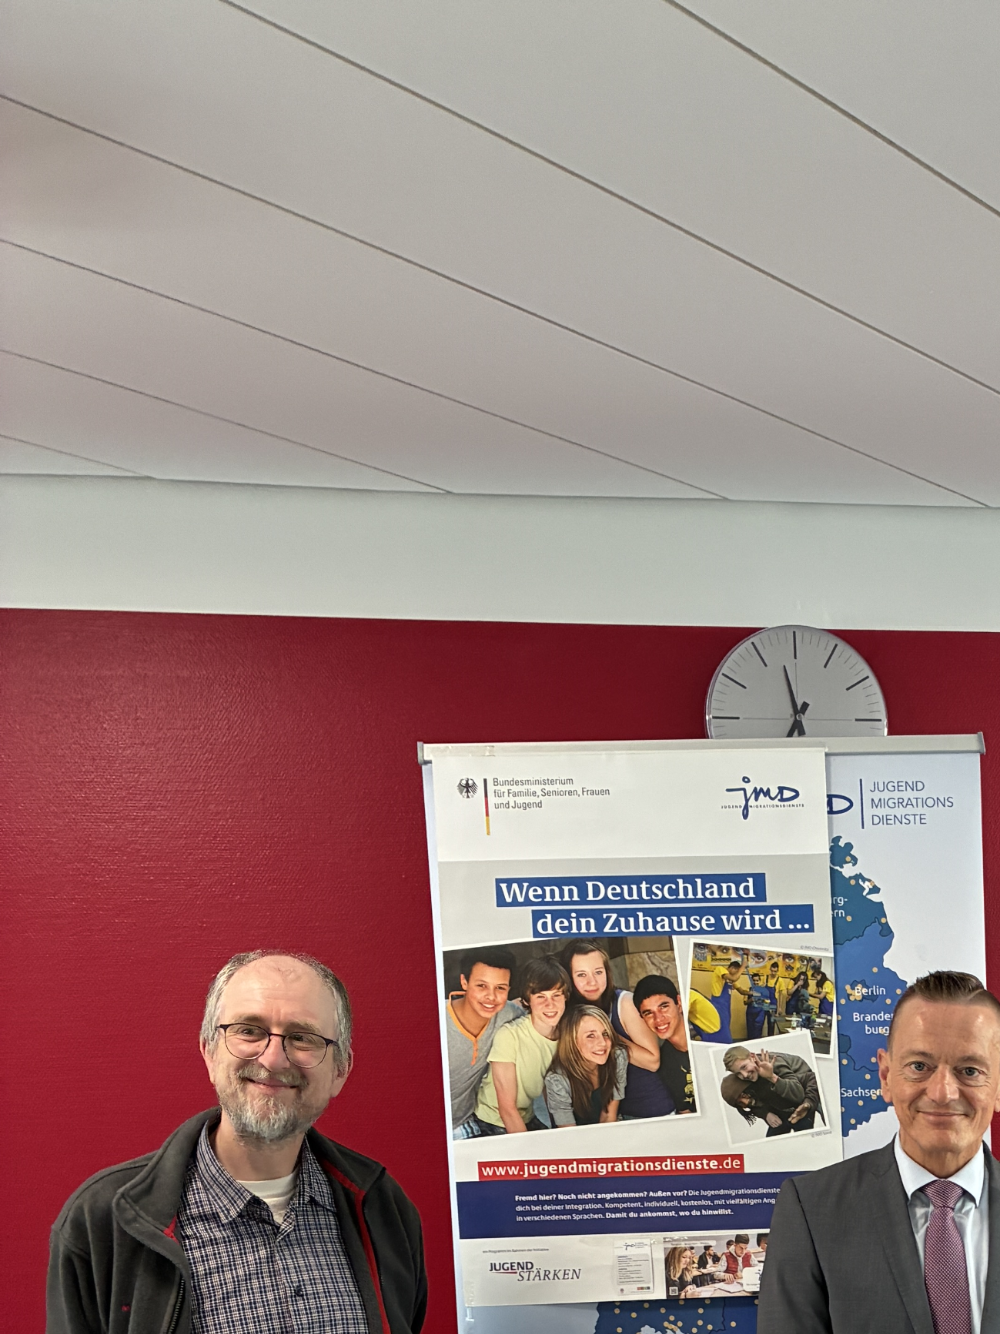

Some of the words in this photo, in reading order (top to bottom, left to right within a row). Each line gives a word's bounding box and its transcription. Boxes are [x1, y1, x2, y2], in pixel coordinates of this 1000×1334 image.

[493, 777, 574, 786] Bundesministerium
[870, 781, 925, 793] JUGEND
[494, 789, 506, 798] für
[507, 788, 540, 798] Familie,
[541, 788, 580, 797] Senioren,
[582, 787, 610, 796] Frauen
[494, 801, 510, 809] und
[511, 800, 542, 810] Jugend
[871, 796, 954, 809] MIGRATIONS
[871, 814, 927, 826] DIENSTE
[500, 882, 578, 903] Wenn
[585, 877, 756, 901] Deutschland
[536, 911, 597, 935] dein
[602, 911, 715, 933] Zuhause
[721, 910, 782, 932] wird
[854, 986, 886, 996] Berlin
[865, 1025, 889, 1035] burg
[482, 1157, 741, 1177] www.jugendmigrationsdienste.de
[489, 1261, 534, 1272] JUGEND
[517, 1268, 581, 1282] STÄRKEN
